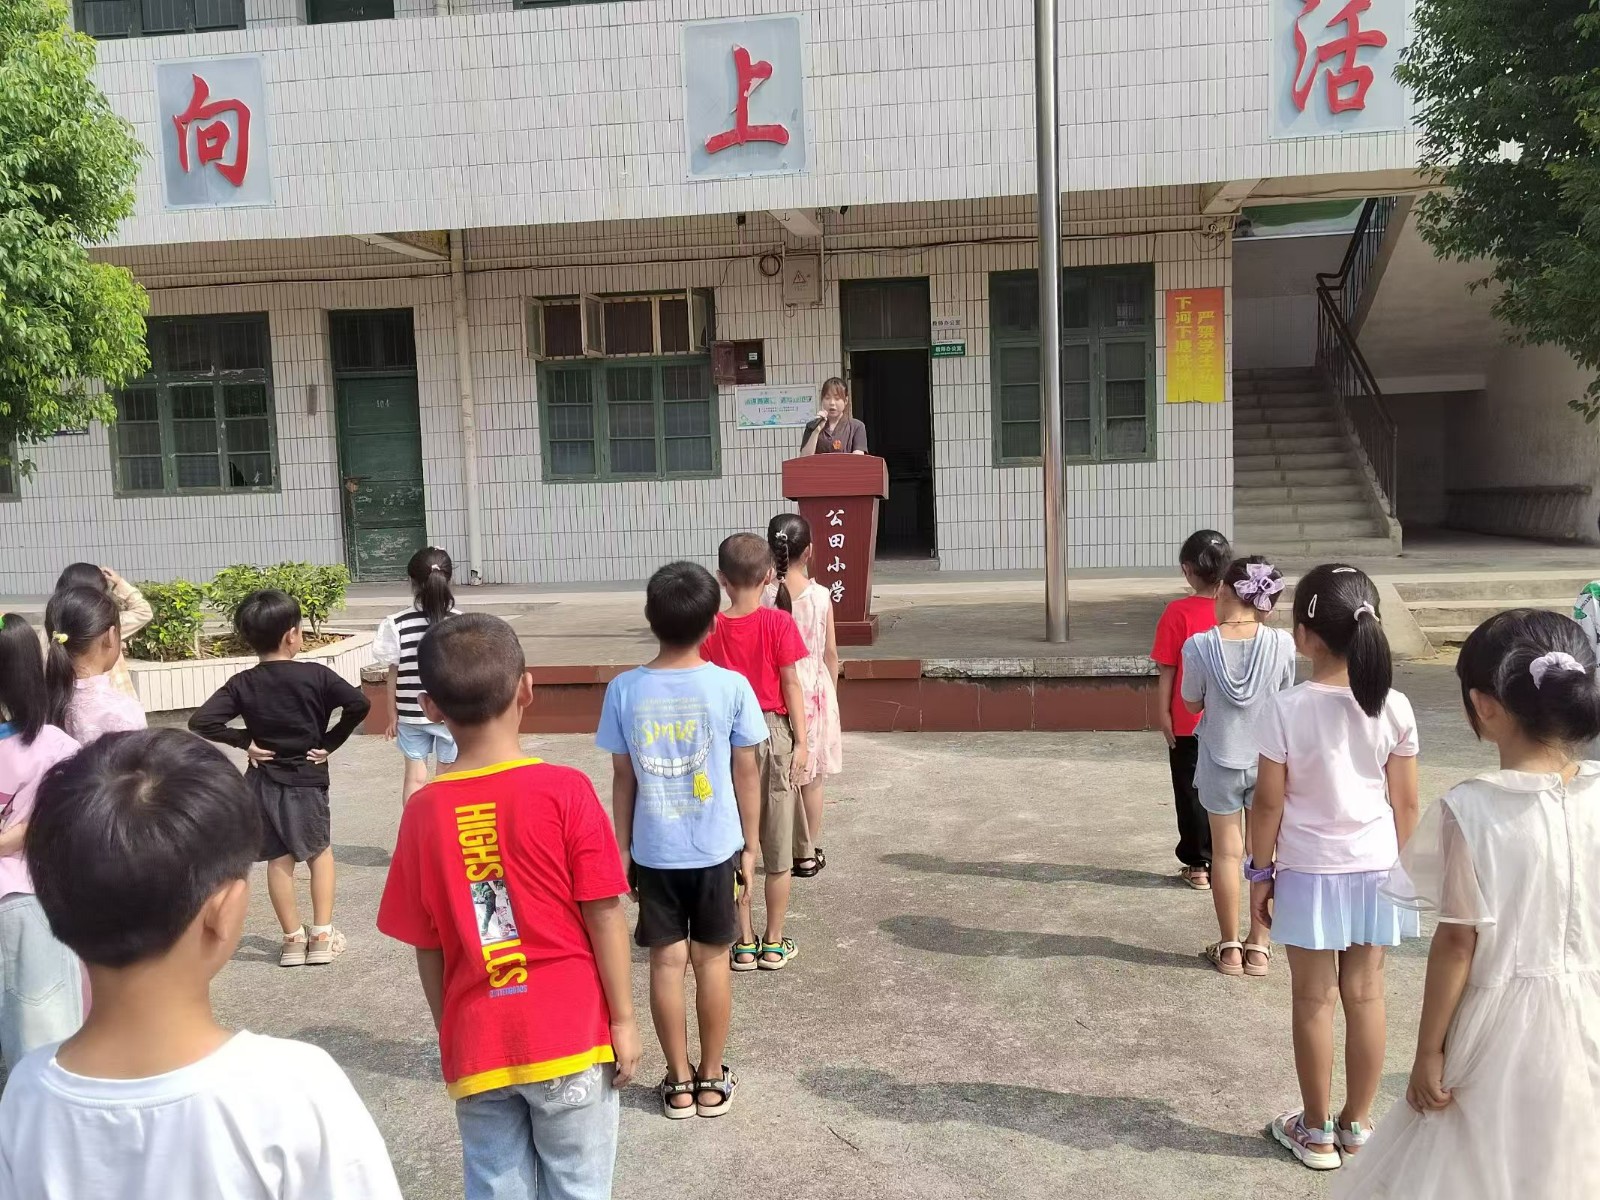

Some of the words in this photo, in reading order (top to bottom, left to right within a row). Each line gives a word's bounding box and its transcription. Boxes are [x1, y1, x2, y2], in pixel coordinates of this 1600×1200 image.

[704, 43, 789, 154] 上
[1291, 0, 1388, 114] 活
[172, 73, 252, 187] 向
[825, 509, 846, 603] 公田小学
[454, 802, 504, 882] HIGHS
